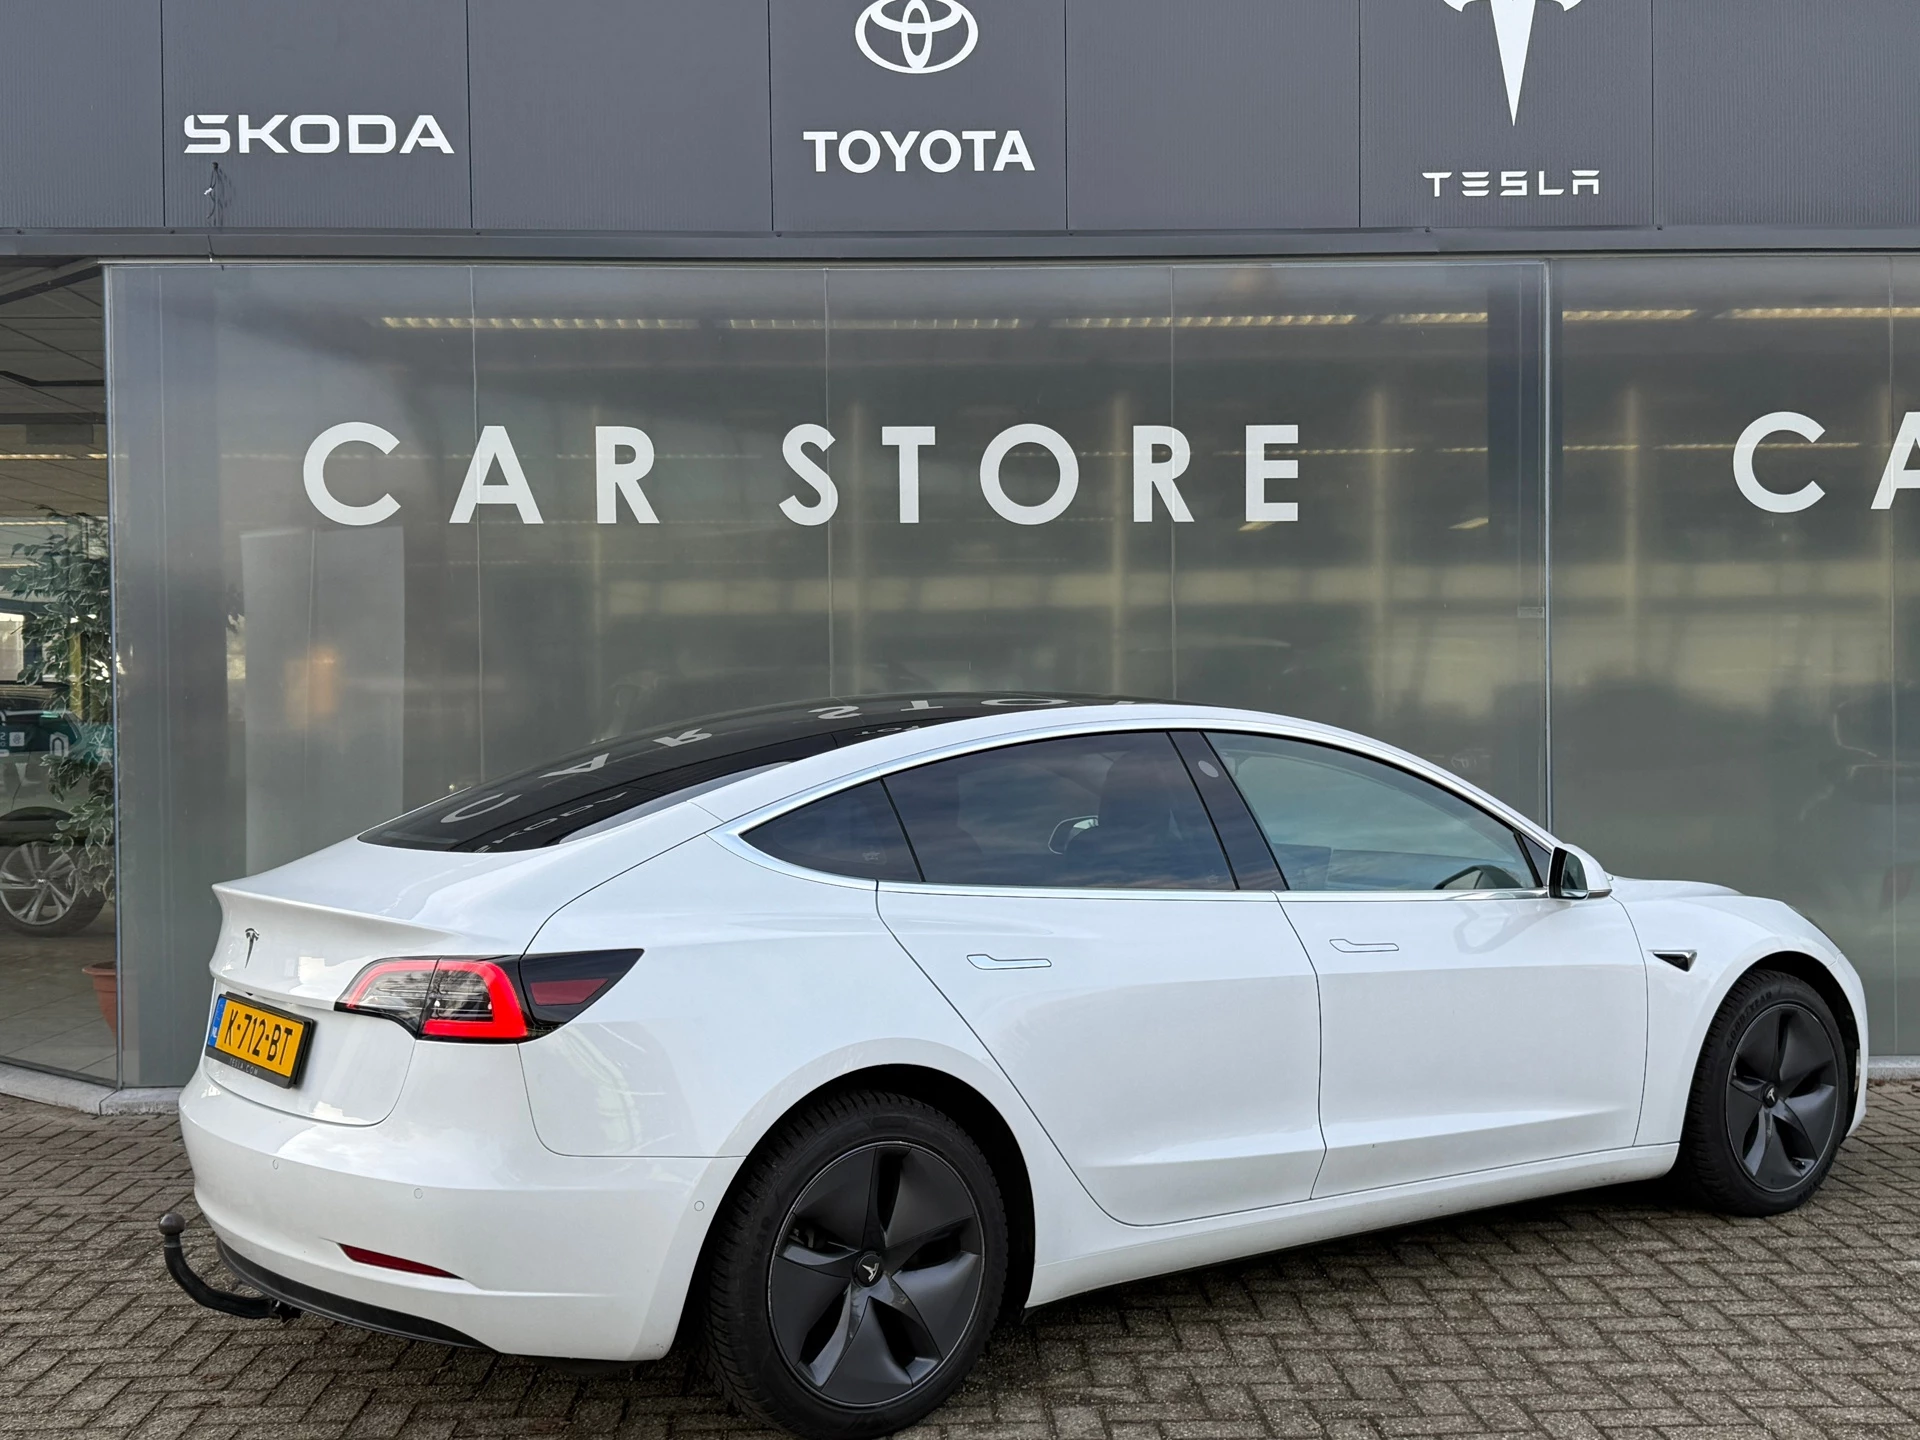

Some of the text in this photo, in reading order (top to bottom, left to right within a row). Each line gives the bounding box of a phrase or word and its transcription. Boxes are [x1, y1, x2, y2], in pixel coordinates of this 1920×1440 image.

[184, 114, 455, 154] SKODA
[802, 129, 1036, 174] TOYOTA
[1422, 169, 1600, 198] TESLA
[303, 421, 1299, 526] CAR STORE
[224, 1008, 294, 1066] K-712-BT
